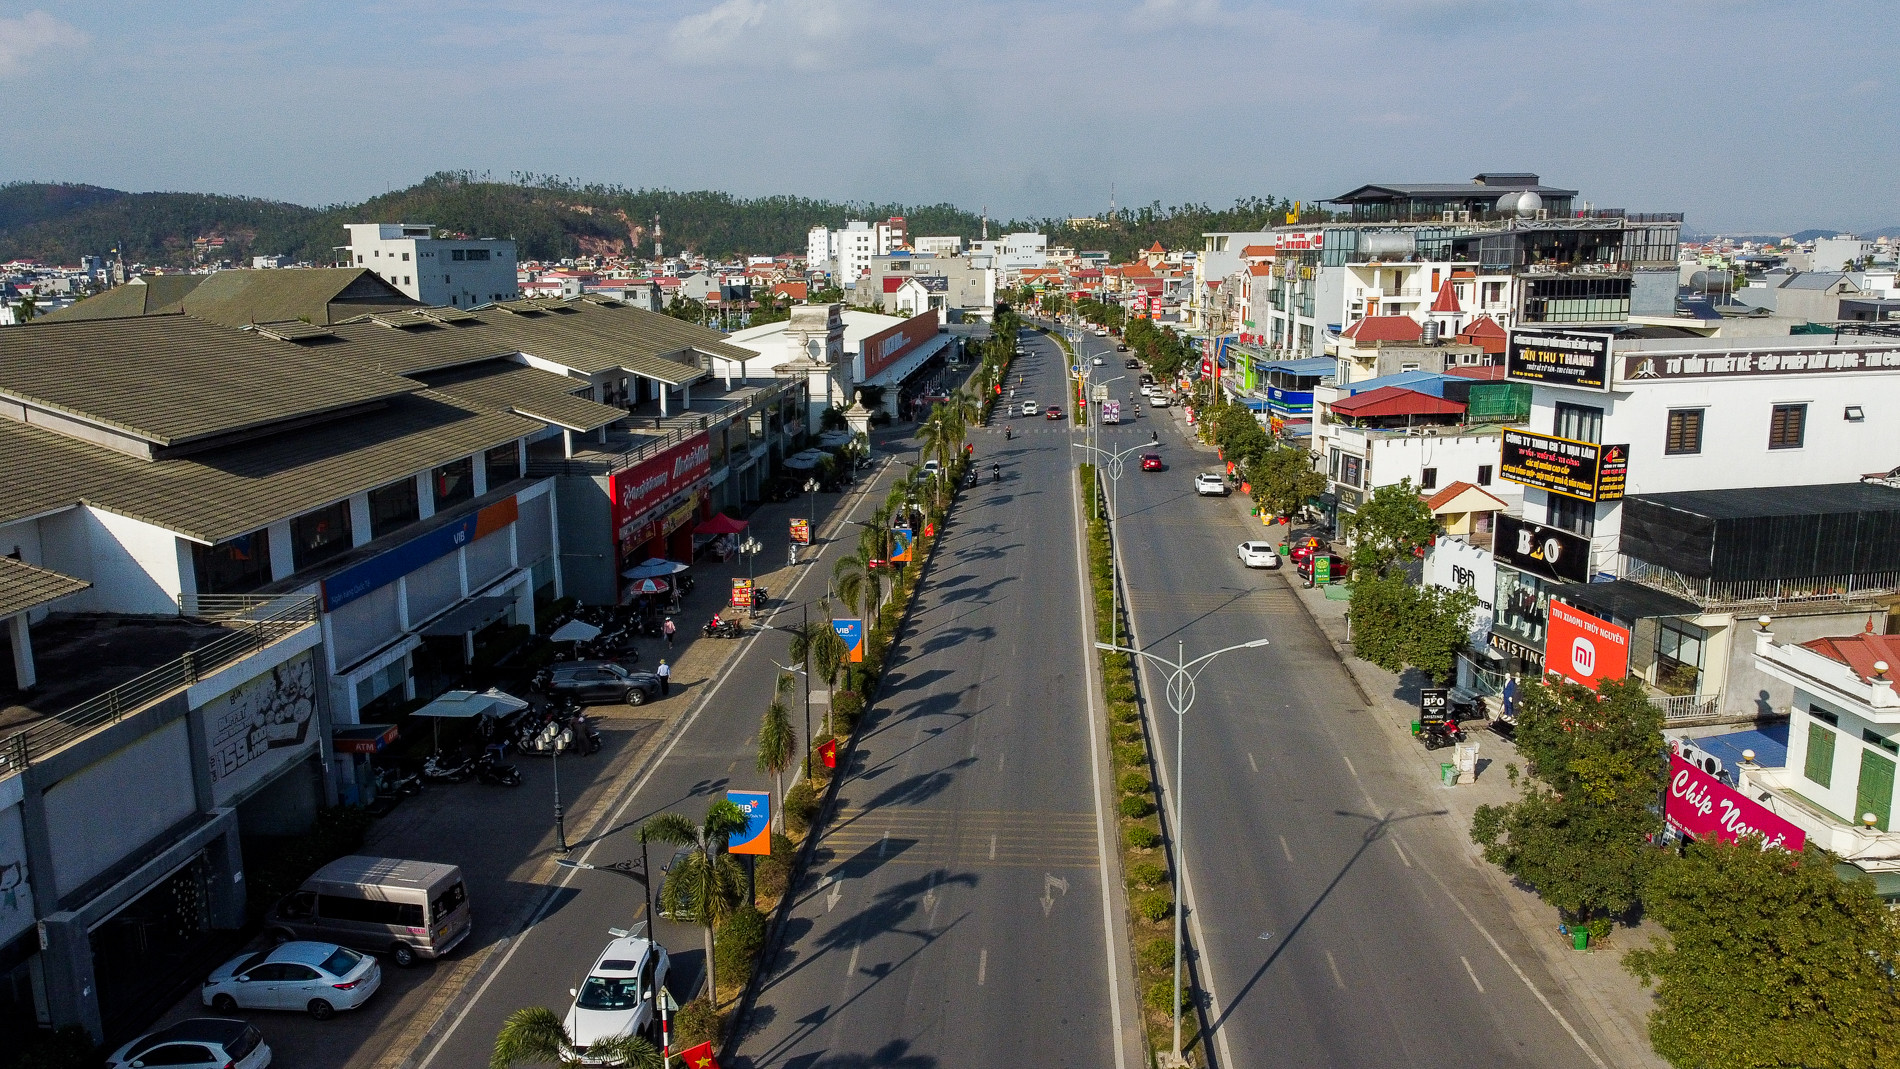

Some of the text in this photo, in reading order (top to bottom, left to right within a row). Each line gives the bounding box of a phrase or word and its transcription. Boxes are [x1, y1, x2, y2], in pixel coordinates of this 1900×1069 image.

[1538, 351, 1557, 364] THU
[1549, 442, 1566, 453] CHU
[454, 530, 465, 544] VIB
